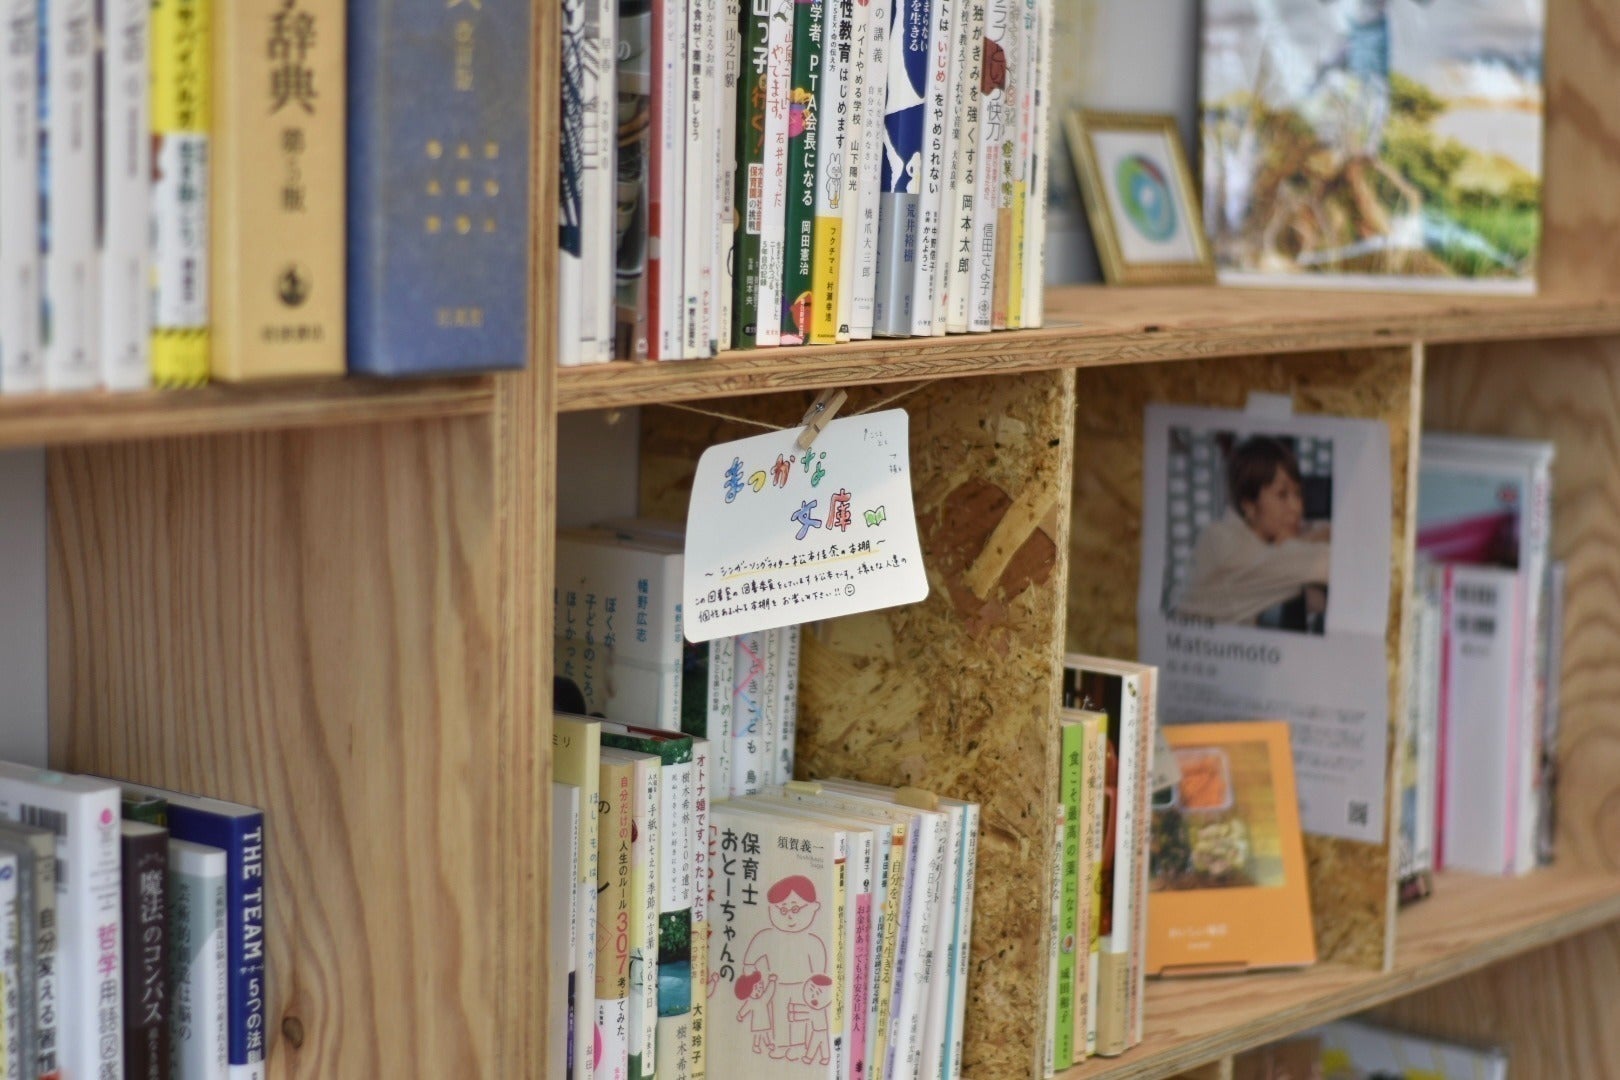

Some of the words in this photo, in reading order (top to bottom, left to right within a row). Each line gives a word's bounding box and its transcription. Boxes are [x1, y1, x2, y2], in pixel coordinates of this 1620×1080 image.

[852, 24, 867, 126] バイトやめる学校
[848, 141, 859, 191] 山下陽光
[958, 195, 973, 274] 岡本太郎
[791, 488, 852, 541] 文庫
[1166, 632, 1282, 664] Matsumoto
[242, 827, 262, 880] THE
[741, 832, 761, 906] 保育士
[777, 836, 824, 853] 須賀義一
[242, 886, 263, 961] TEAM
[719, 827, 739, 983] おとーちゃんの
[139, 870, 164, 1025] 魔法のコンパス
[691, 1003, 703, 1064] 大塚玲子
